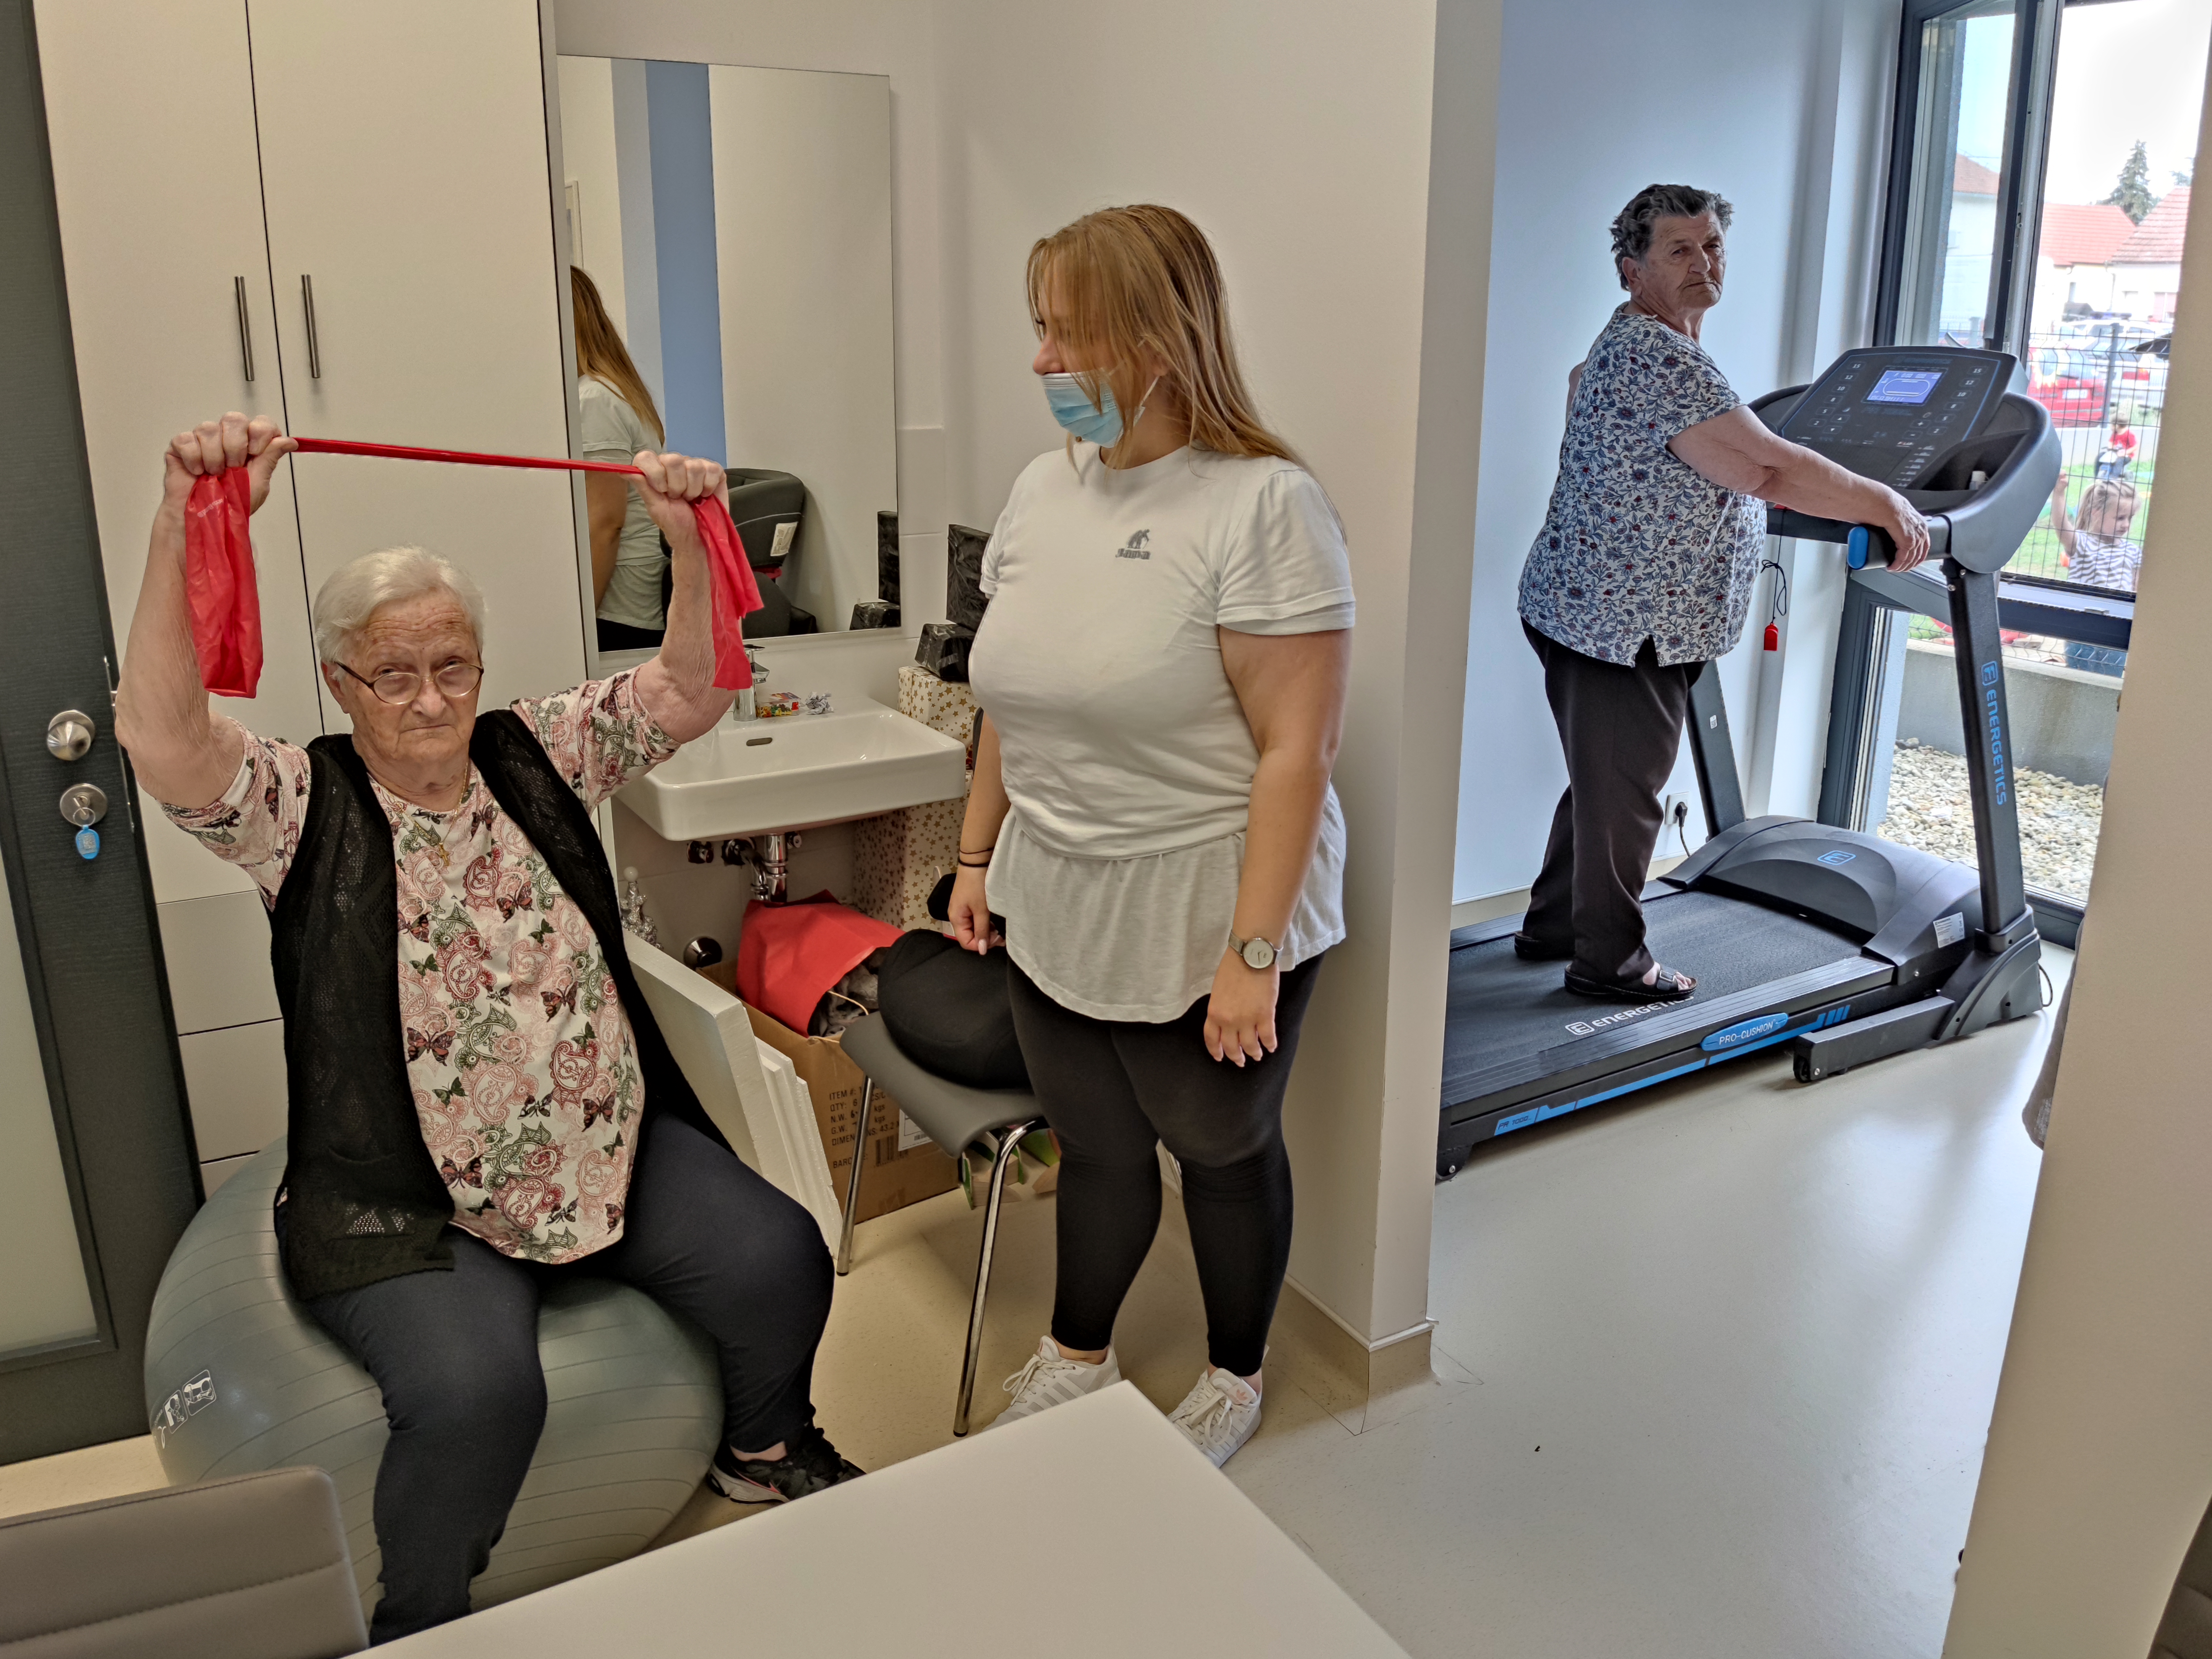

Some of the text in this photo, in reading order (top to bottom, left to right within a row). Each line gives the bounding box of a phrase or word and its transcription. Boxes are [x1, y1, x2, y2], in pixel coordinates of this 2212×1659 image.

[1986, 689, 2007, 805] ENERGETICS
[1719, 1021, 1773, 1045] PRO-CUSHION
[830, 1090, 847, 1100] ITEM
[830, 1102, 847, 1112] QTY:
[831, 1114, 847, 1123] N.W.
[874, 1104, 885, 1112] kgs
[831, 1116, 885, 1134] G.W. kgs
[1498, 1116, 1528, 1130] PR 1000
